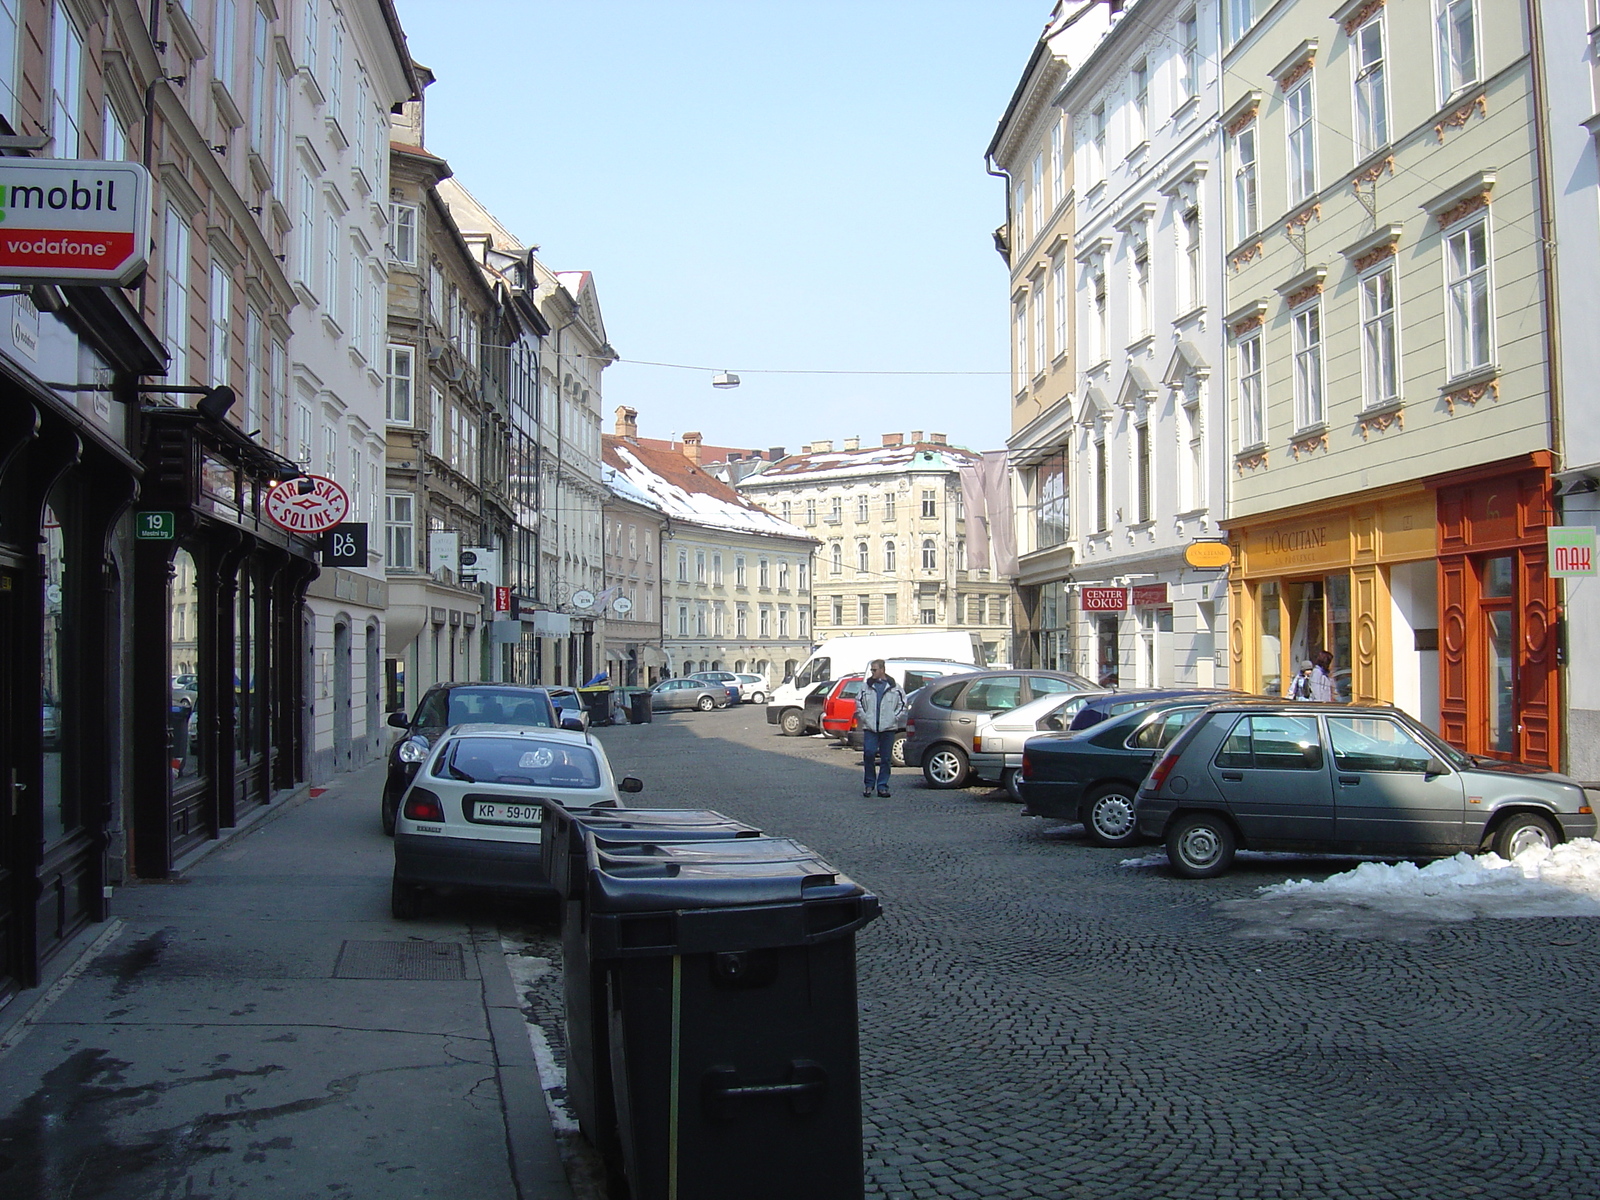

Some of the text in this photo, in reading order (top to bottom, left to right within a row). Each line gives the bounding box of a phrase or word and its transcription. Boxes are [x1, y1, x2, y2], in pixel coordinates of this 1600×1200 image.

[272, 481, 343, 506] PIRSKE
[146, 514, 163, 529] 19
[279, 508, 334, 529] SOLINE
[1555, 547, 1591, 571] MAK
[1086, 590, 1122, 599] CENTER
[1087, 598, 1123, 609] ROKUS
[479, 804, 495, 817] KR
